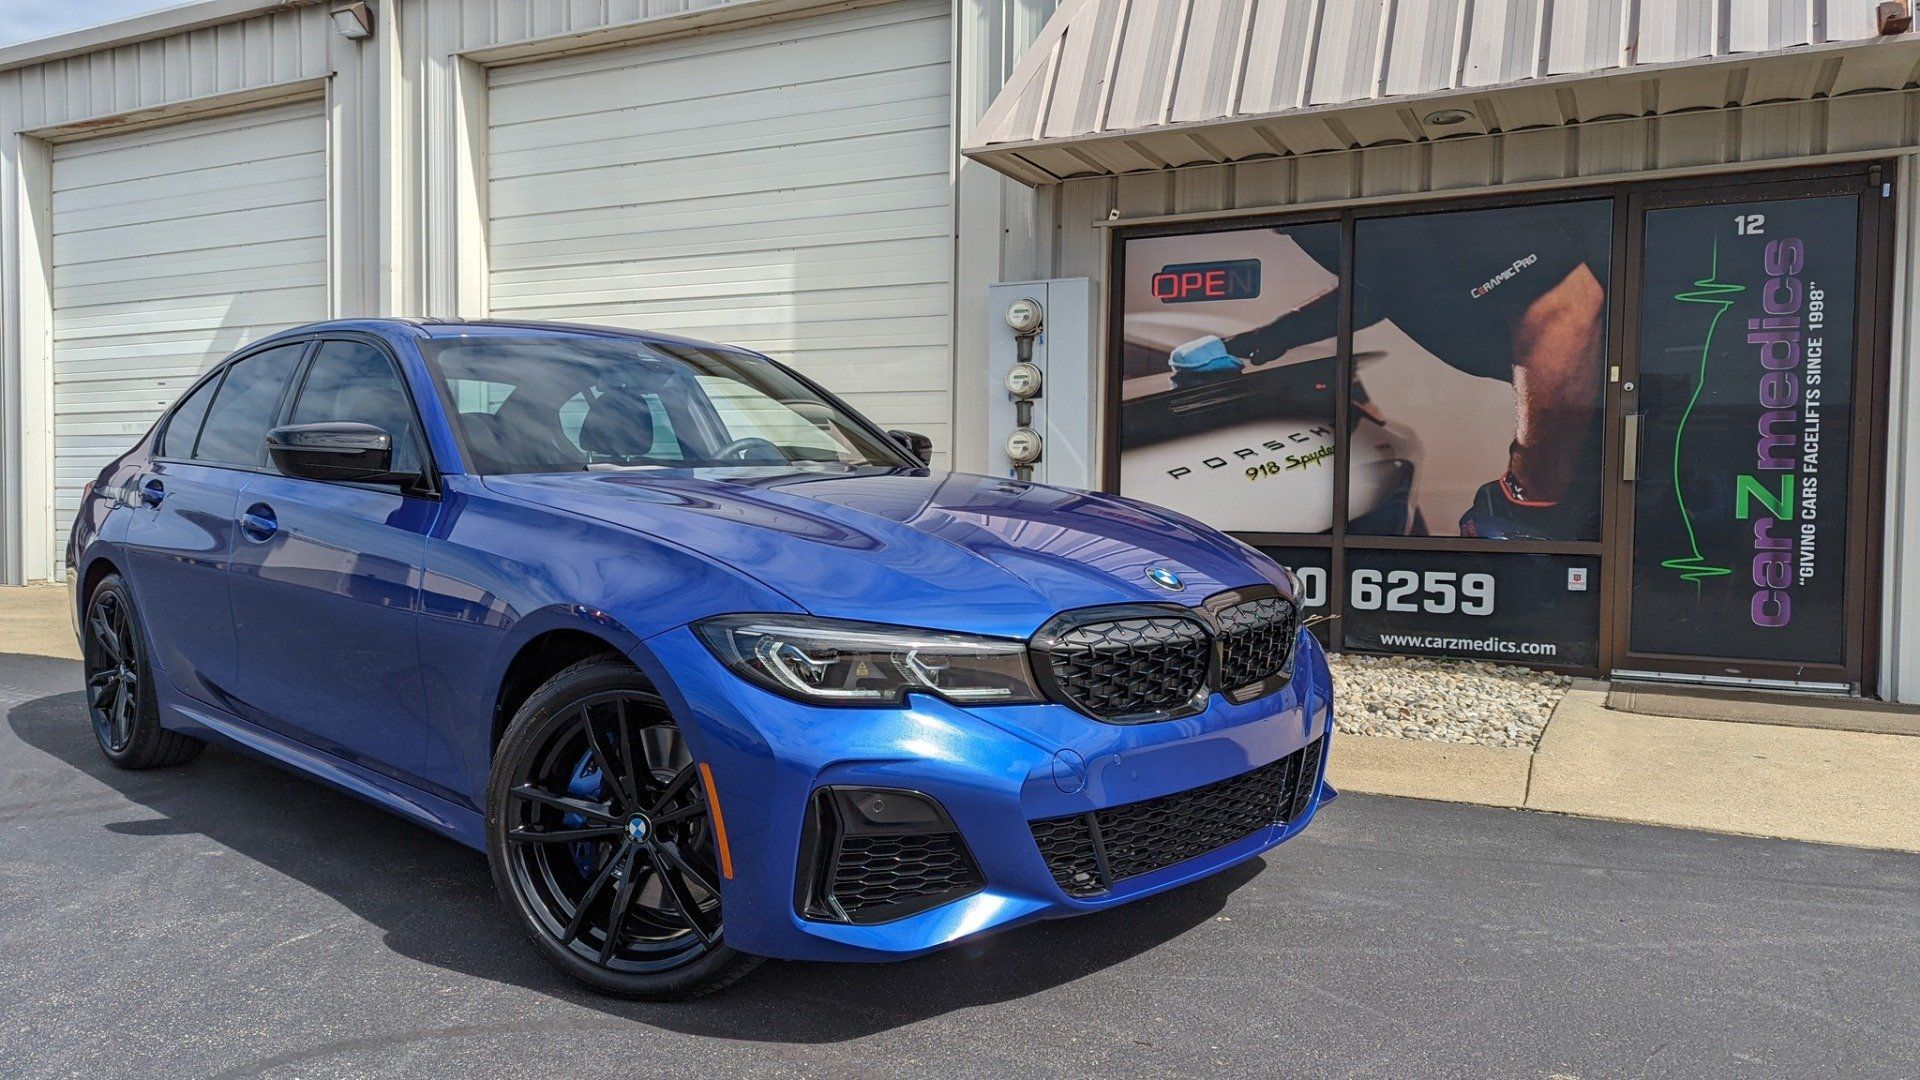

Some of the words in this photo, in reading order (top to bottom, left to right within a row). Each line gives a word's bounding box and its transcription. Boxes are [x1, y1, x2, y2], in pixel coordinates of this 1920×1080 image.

[1734, 215, 1765, 235] 12
[1154, 270, 1250, 299] OPEN
[1806, 337, 1823, 385] SINCE
[1167, 425, 1333, 480] PORSCH
[1736, 237, 1804, 627] carZmedics
[1803, 389, 1821, 473] FACELIFTS
[1245, 460, 1281, 481] 918
[1802, 477, 1817, 520] CARS
[1351, 568, 1495, 616] 6259
[1380, 633, 1557, 656] www.carzmedics.com
